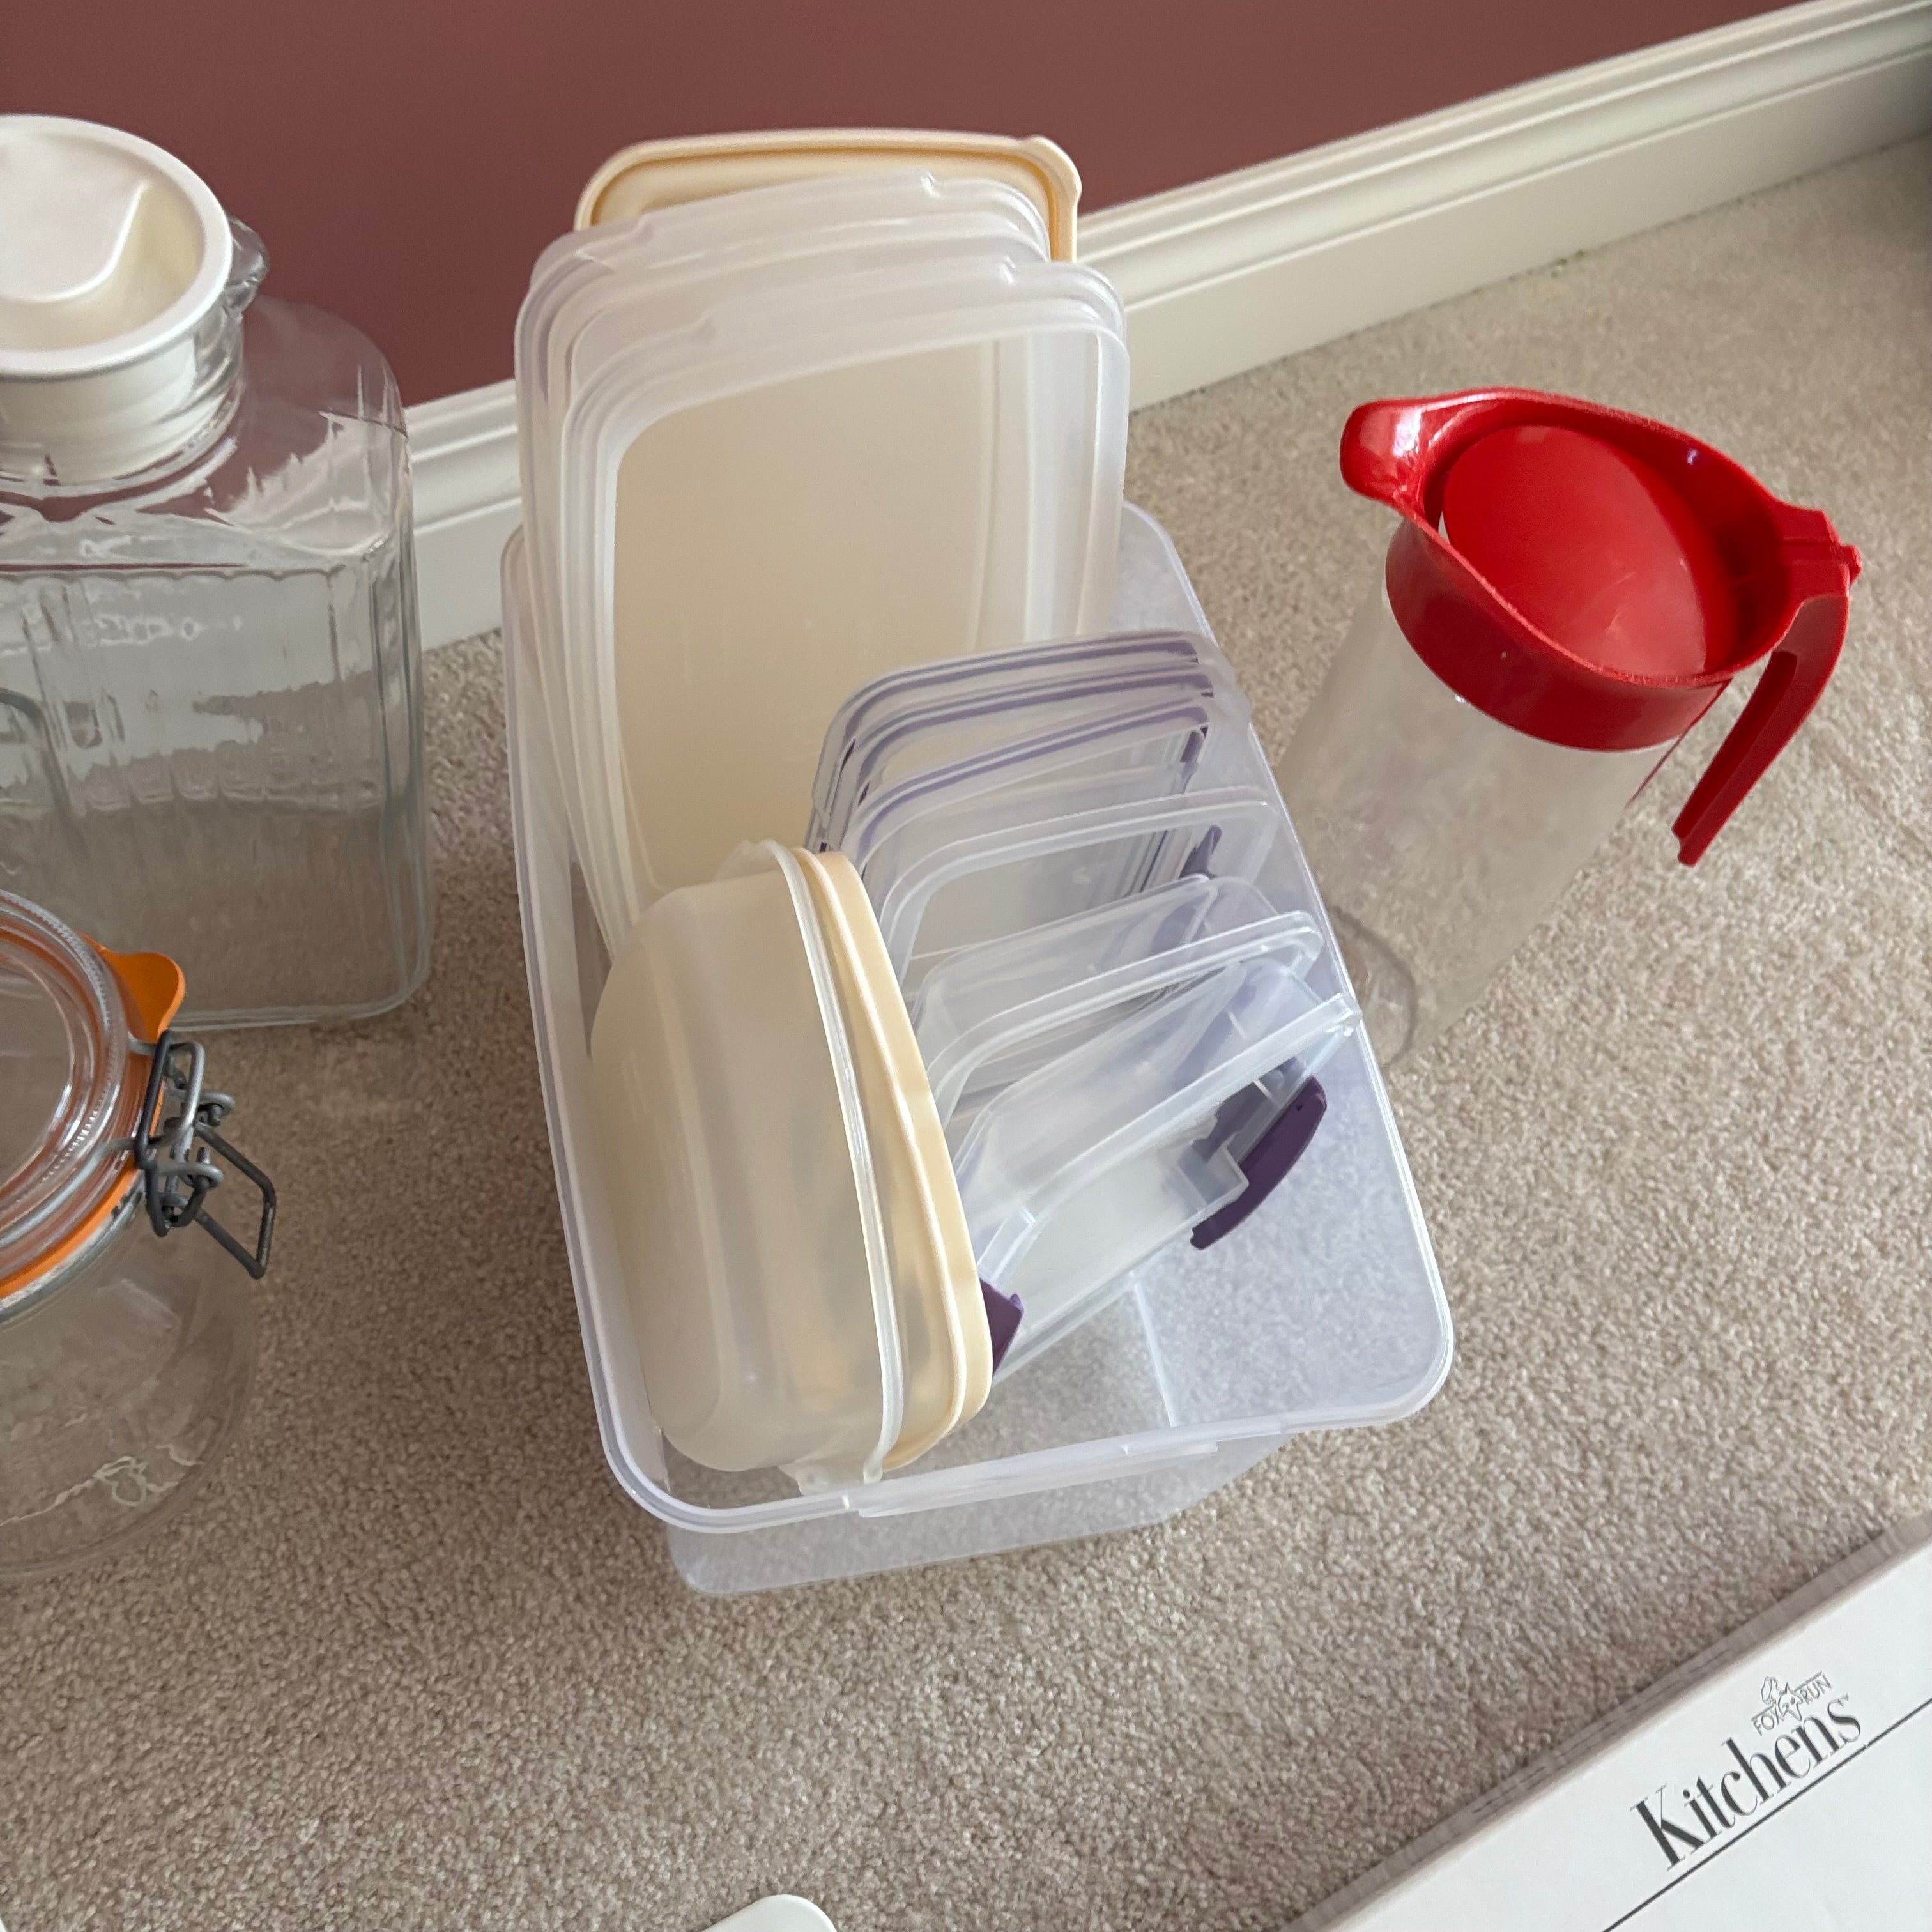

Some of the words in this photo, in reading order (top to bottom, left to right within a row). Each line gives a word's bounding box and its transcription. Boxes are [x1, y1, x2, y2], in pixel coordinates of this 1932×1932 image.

[1752, 1705, 1784, 1736] FOX
[1798, 1672, 1832, 1705] RUN
[1630, 1699, 1861, 1871] Kitchens
